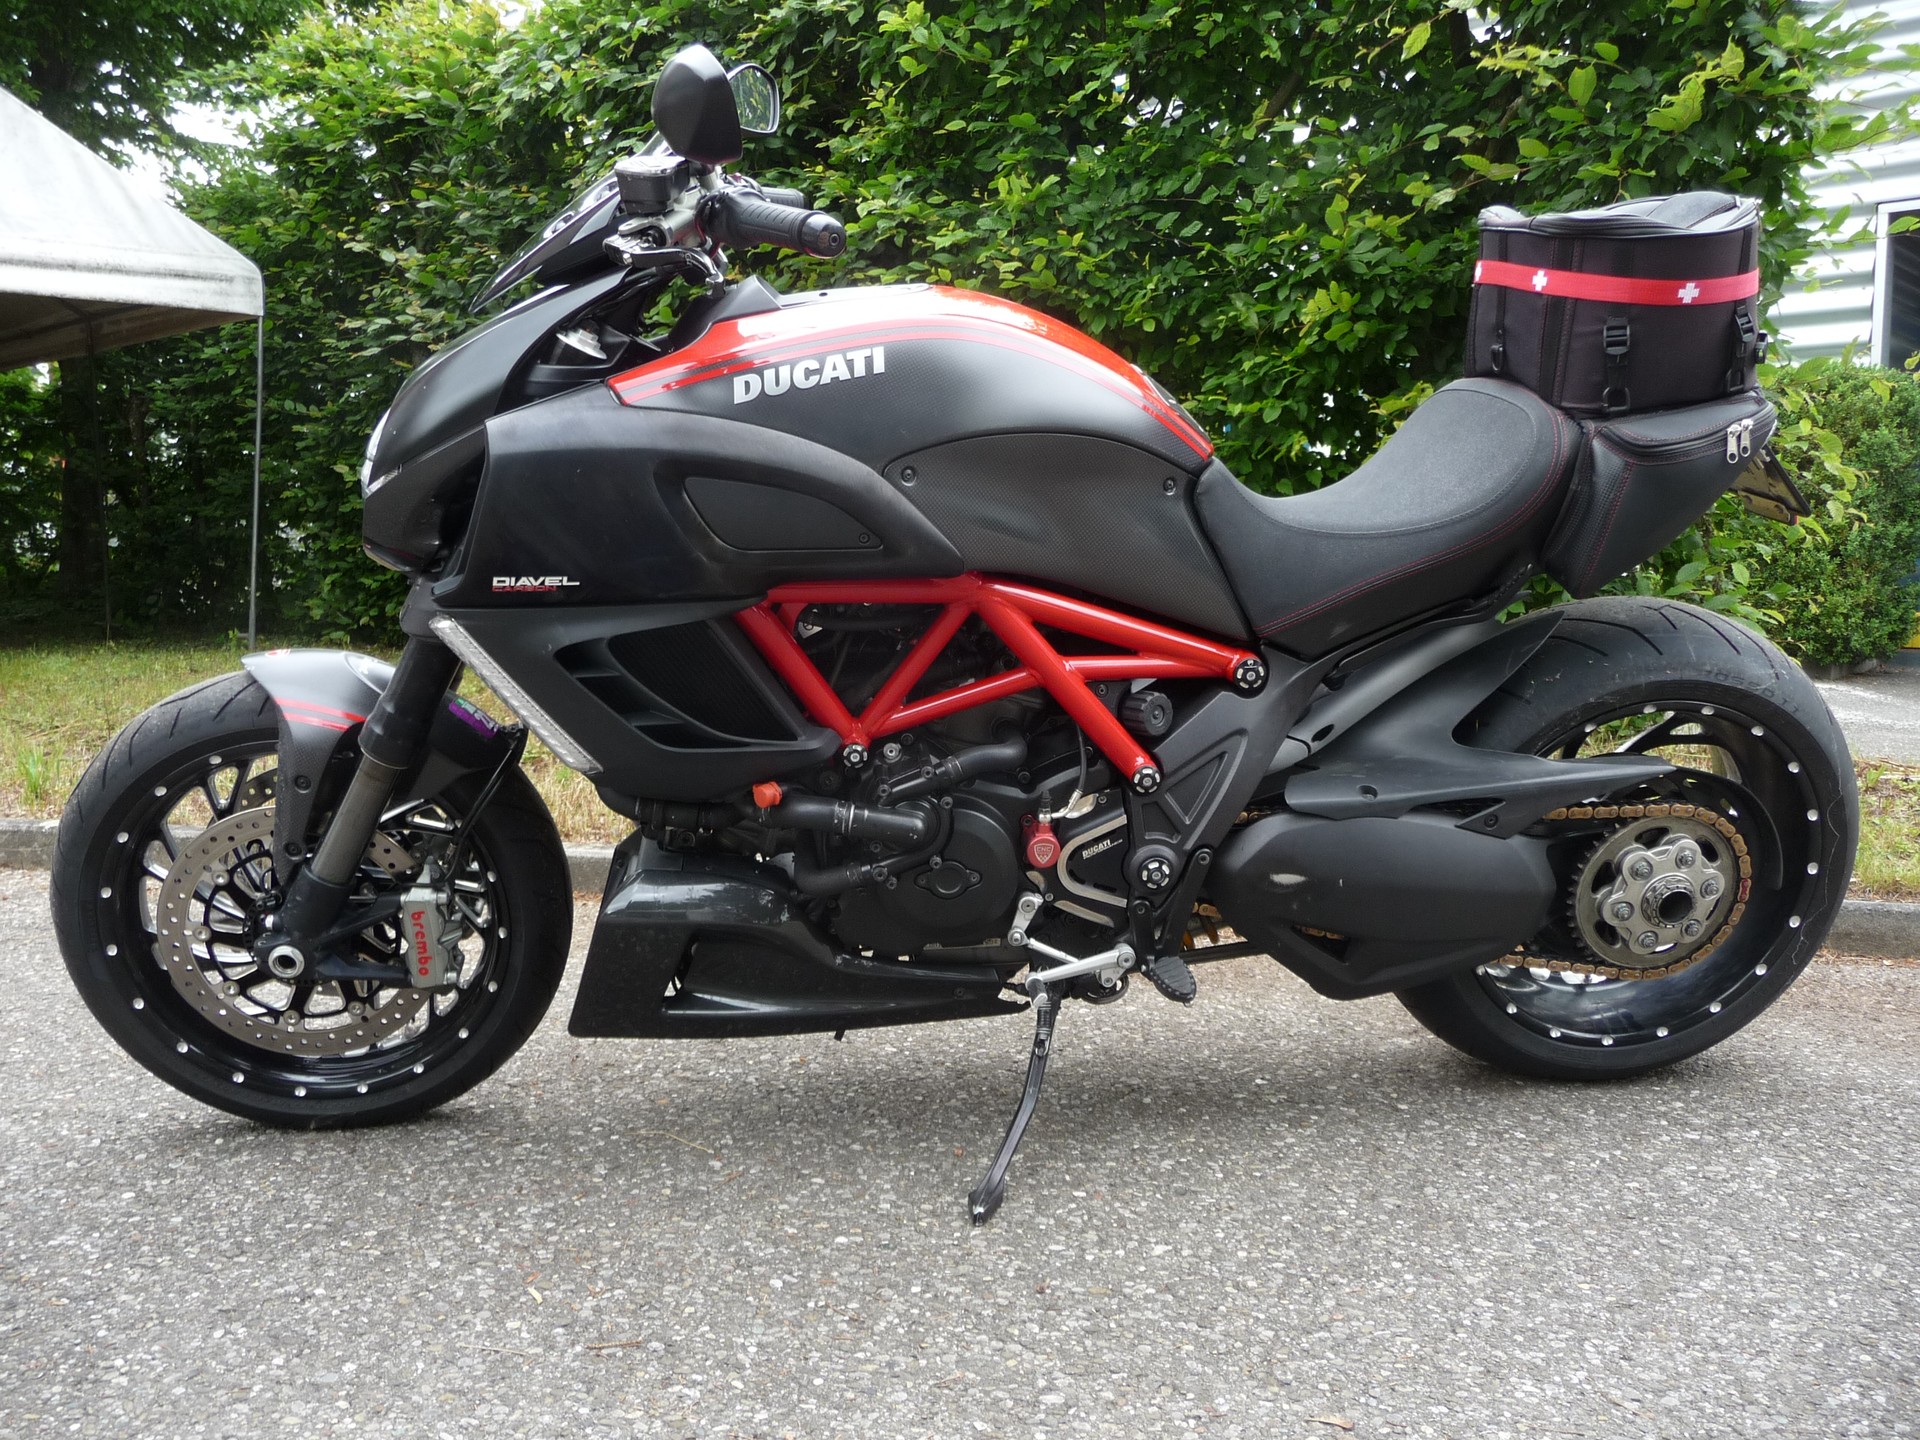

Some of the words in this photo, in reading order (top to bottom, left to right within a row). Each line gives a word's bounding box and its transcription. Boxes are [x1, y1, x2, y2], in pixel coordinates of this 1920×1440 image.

[733, 346, 885, 405] DUCATI
[492, 575, 580, 587] DIAVEL
[1082, 838, 1111, 858] DUCATI
[410, 910, 433, 977] brembo
